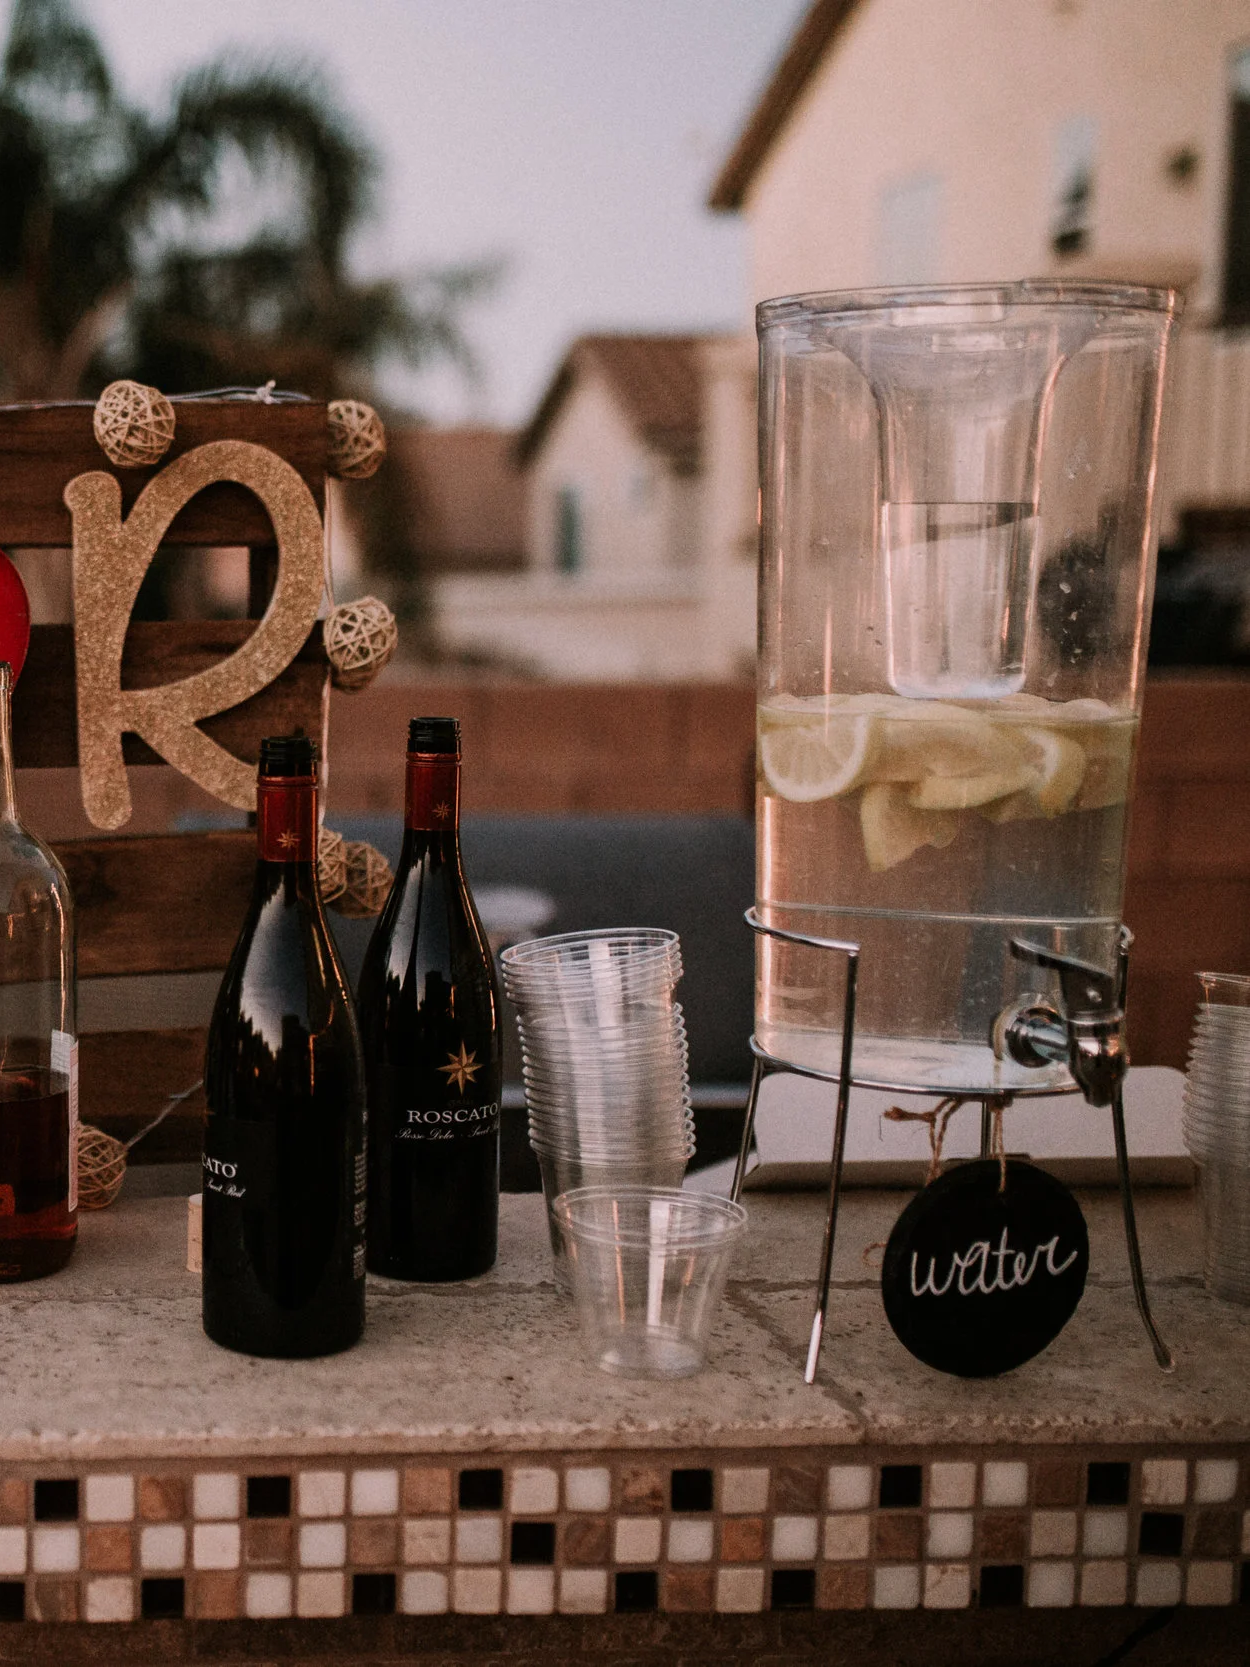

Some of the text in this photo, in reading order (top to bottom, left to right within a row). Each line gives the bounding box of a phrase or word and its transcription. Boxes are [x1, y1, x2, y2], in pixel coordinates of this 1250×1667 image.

[64, 440, 326, 830] R
[406, 1102, 499, 1124] ROSCATO
[201, 1152, 237, 1178] CATO
[910, 1226, 1079, 1298] water
